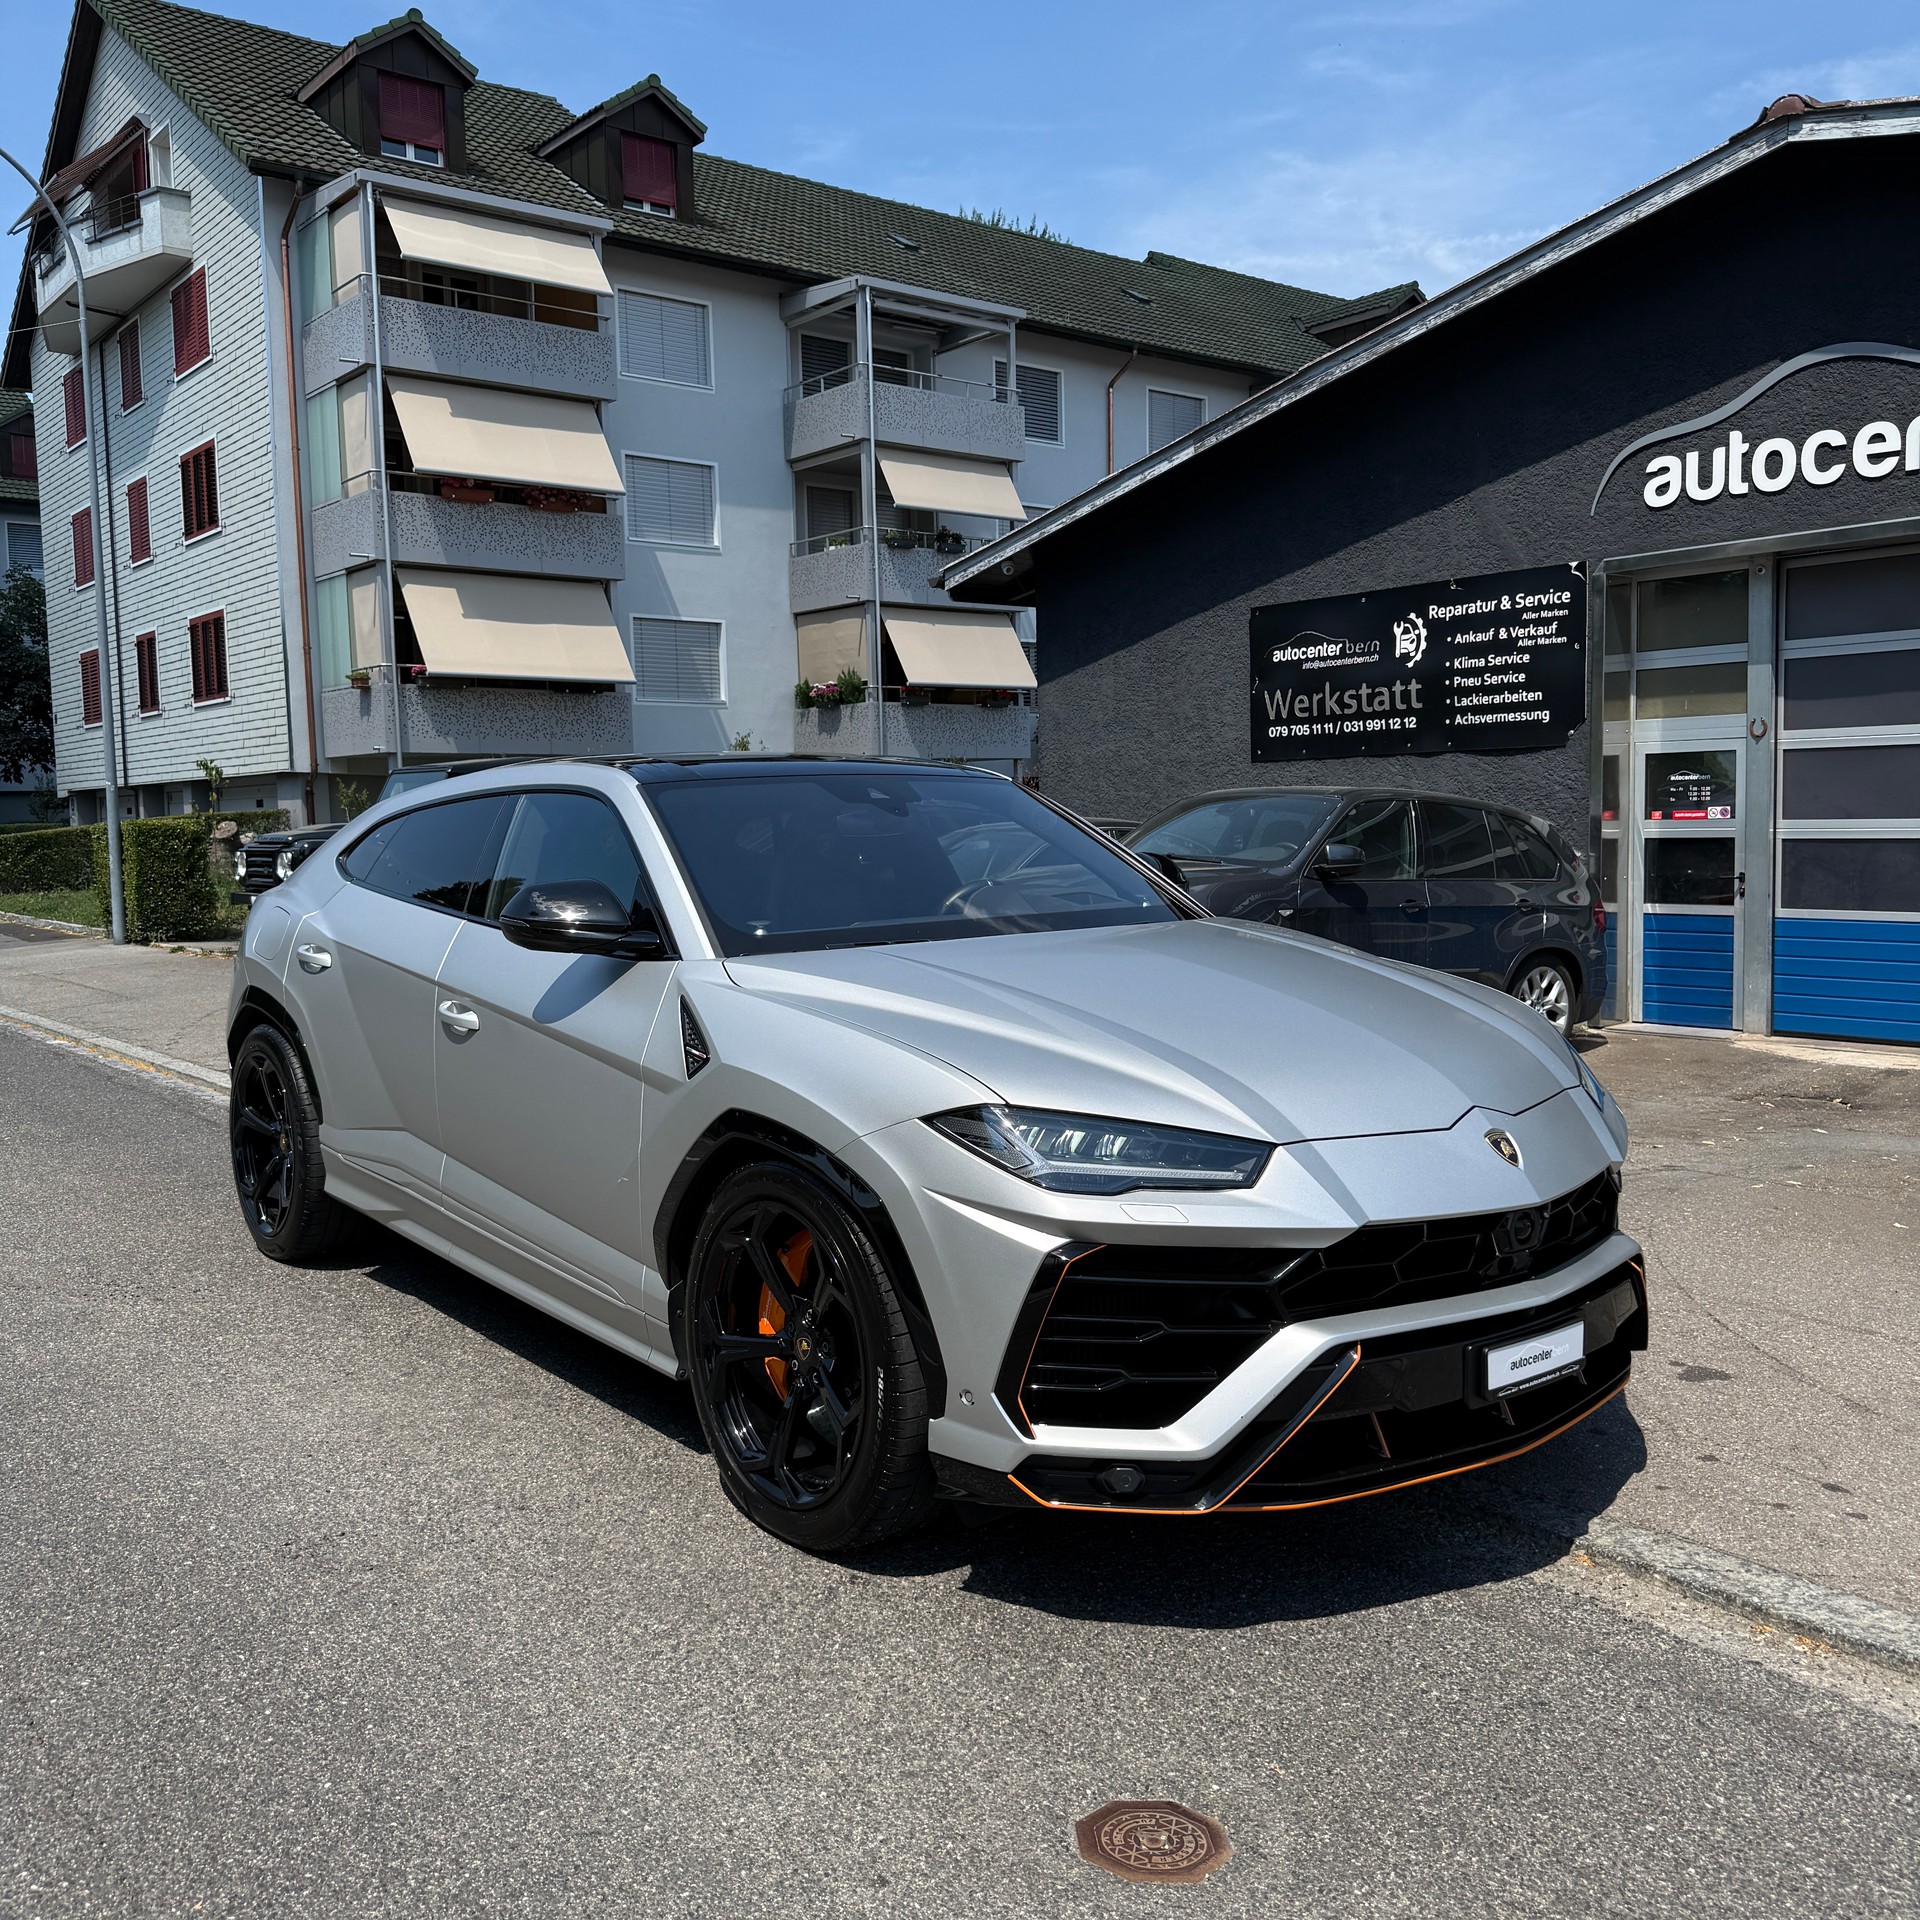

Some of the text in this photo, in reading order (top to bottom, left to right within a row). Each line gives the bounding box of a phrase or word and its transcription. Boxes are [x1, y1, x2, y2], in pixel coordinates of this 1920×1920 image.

[1428, 589, 1571, 621] Reparatur & Service
[1521, 608, 1569, 620] Aller Marken
[1454, 621, 1558, 644] Ankauf & Verkauf
[1517, 635, 1567, 647] Aller Marken
[1272, 639, 1380, 662] autocenter bern
[1453, 652, 1530, 669] Klima Service
[1302, 654, 1379, 670] info@autocenterbern.ch
[1453, 671, 1526, 688] Pneu Service
[1264, 678, 1423, 720] Werkstatt
[1454, 690, 1543, 707] Lackierarbeiten
[1268, 717, 1417, 738] 079 705 11 11 / 031 991 12 12
[1454, 710, 1550, 725] Achsvermessung
[1510, 1348, 1553, 1371] autocenter
[876, 1365, 885, 1431] 285/40
[1160, 1836, 1194, 1862] ASSER
